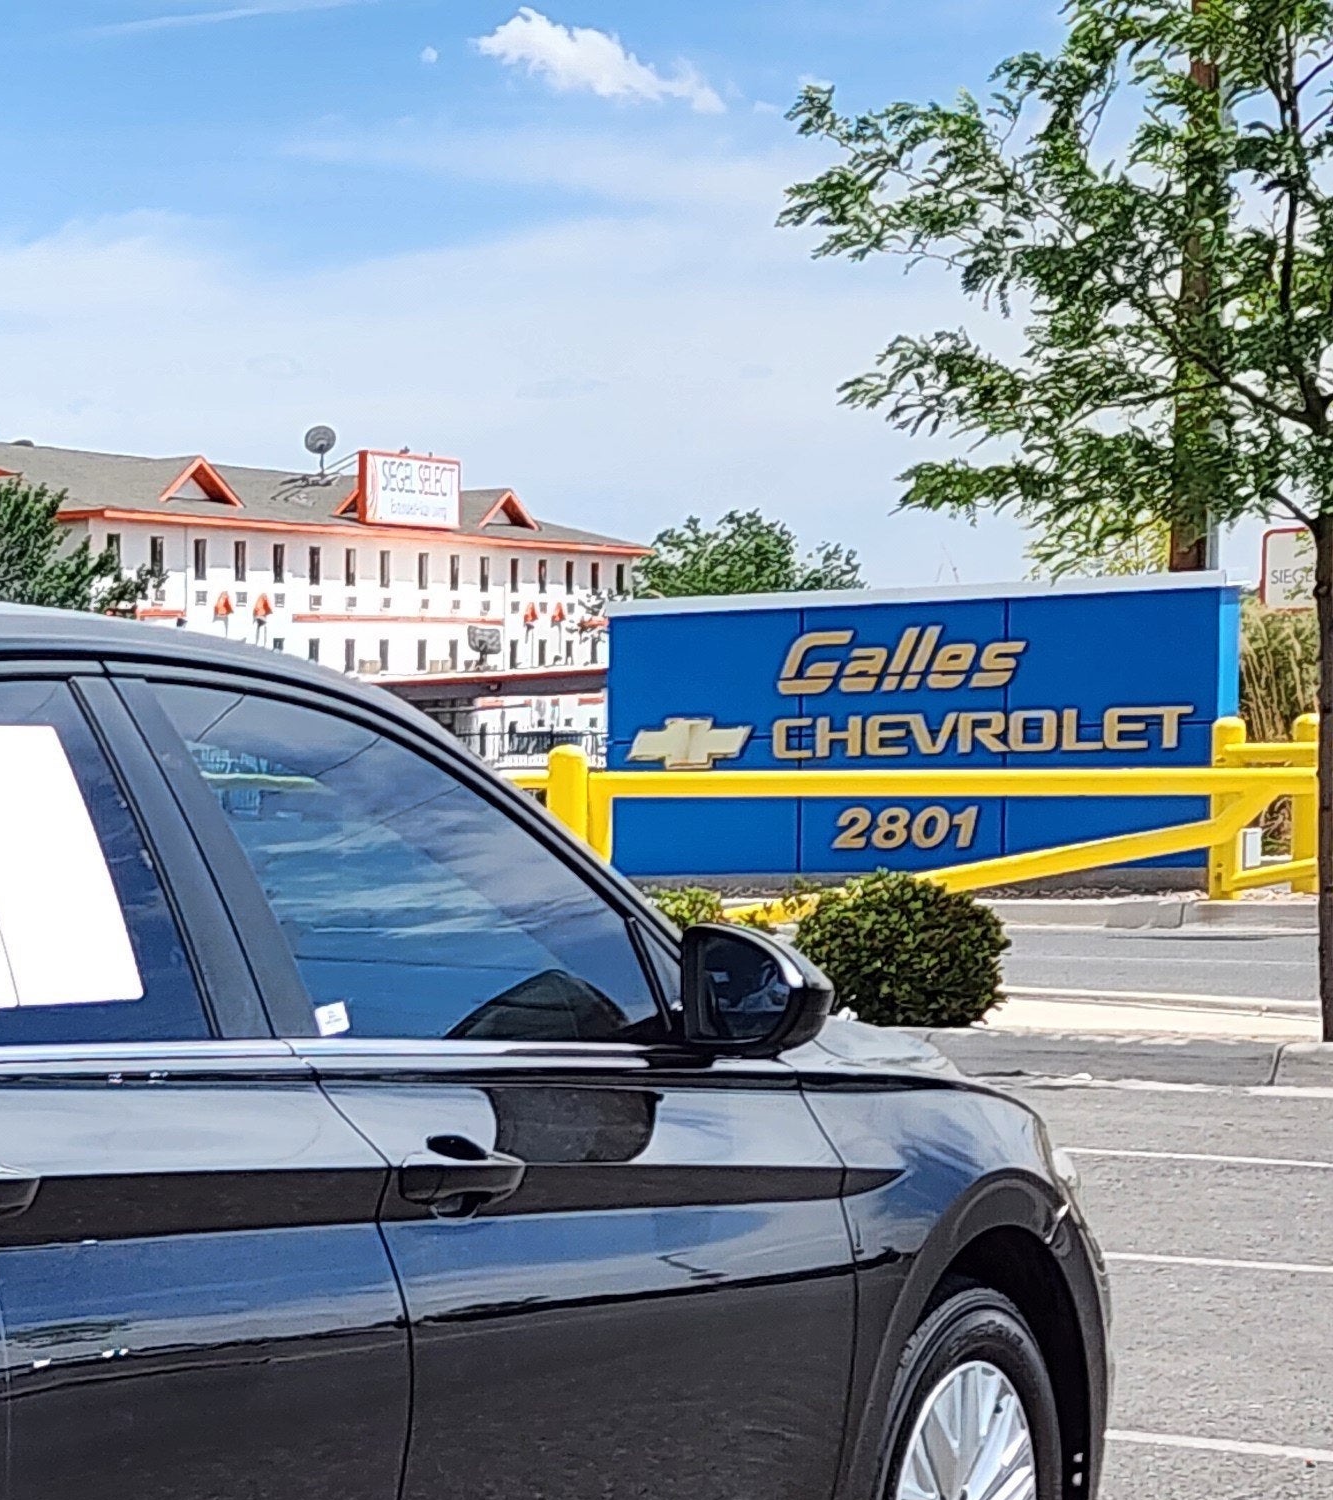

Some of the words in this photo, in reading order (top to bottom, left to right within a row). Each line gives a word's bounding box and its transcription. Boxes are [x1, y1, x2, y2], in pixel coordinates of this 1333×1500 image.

[1270, 566, 1314, 585] SIEGE
[777, 625, 1027, 695] Galles
[772, 705, 1194, 760] CHEVROLET
[832, 805, 979, 849] 2801
